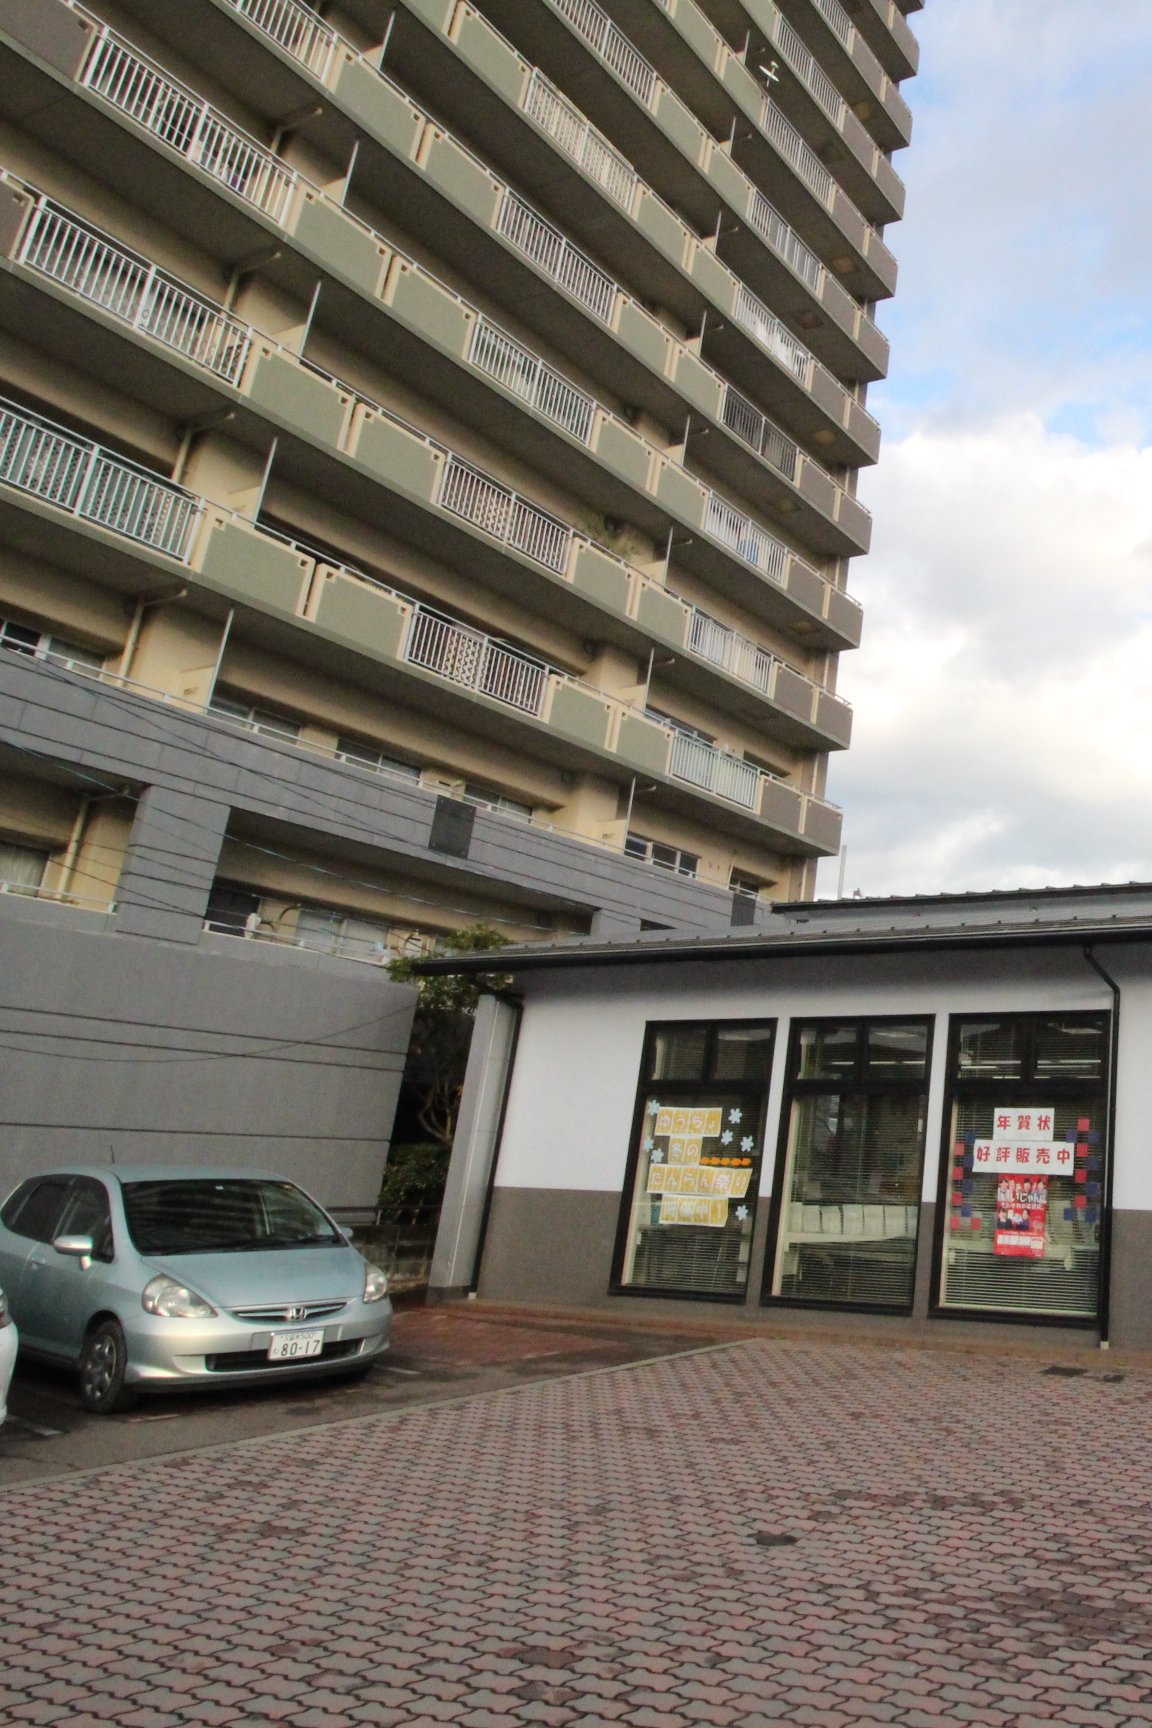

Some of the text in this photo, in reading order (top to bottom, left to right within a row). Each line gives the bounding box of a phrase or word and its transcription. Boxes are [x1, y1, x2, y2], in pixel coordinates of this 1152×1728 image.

[996, 1114, 1052, 1132] 年賀状
[976, 1145, 1071, 1166] 好評販売中
[280, 1340, 321, 1357] 80-17
